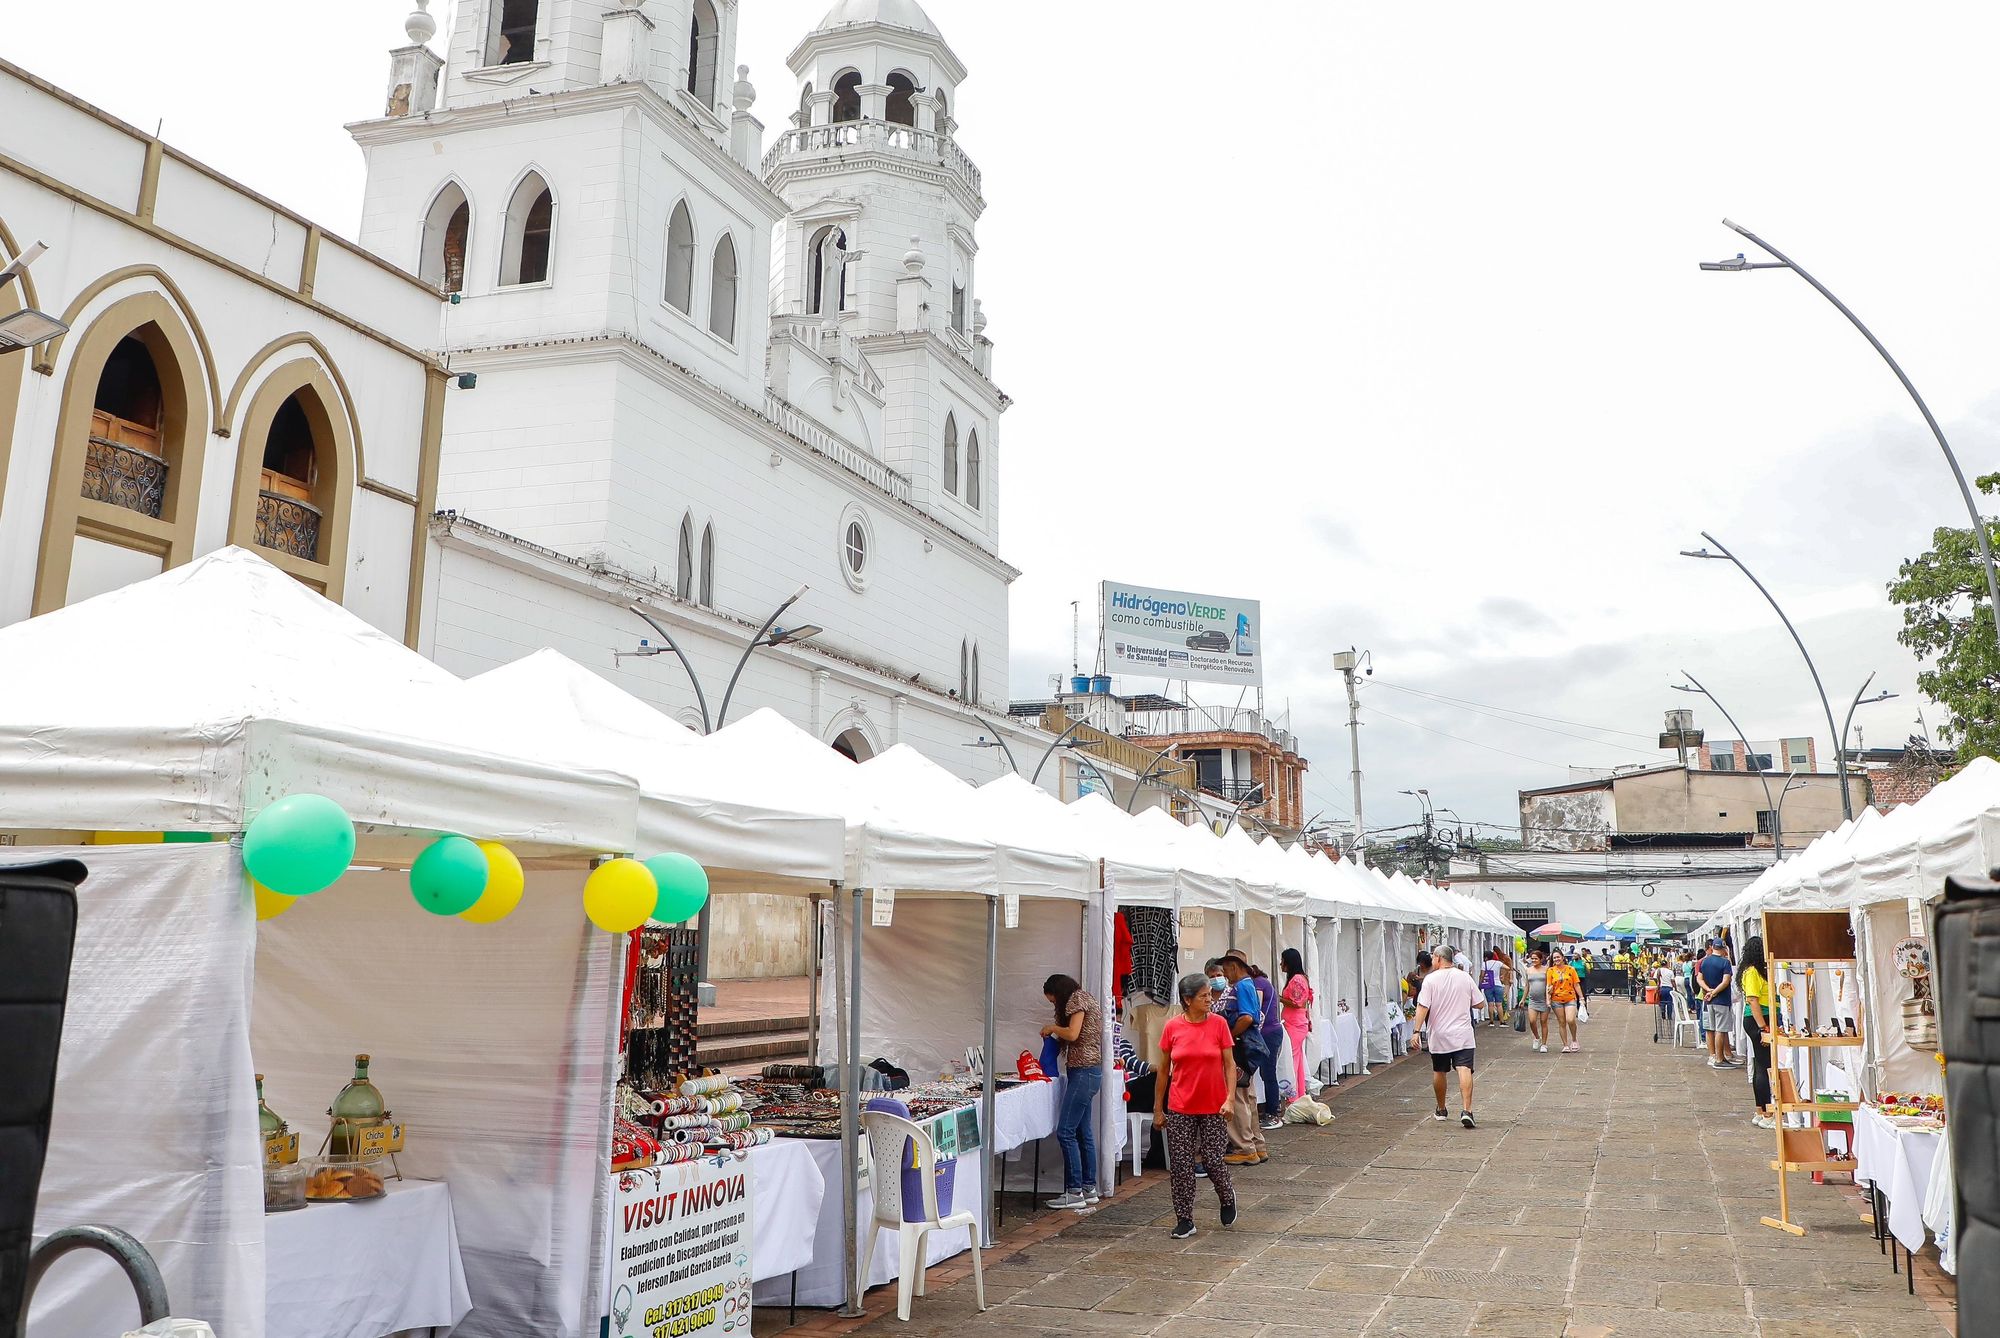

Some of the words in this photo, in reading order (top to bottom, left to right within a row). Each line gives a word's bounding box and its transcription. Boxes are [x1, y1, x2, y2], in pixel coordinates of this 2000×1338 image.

[1112, 612, 1140, 625] como
[1143, 617, 1204, 632] combustible
[1126, 645, 1168, 656] Universidad
[1126, 652, 1135, 660] de
[1136, 653, 1168, 663] Santander
[1190, 655, 1219, 664] Doctorado
[1227, 659, 1252, 667] Recursos
[1190, 663, 1223, 672] Energéticos
[1224, 666, 1255, 674] Renovables
[366, 1131, 385, 1140] Chicha
[363, 1147, 383, 1156] Corozo
[624, 1192, 678, 1234] VISUT
[681, 1173, 746, 1217] INNOVA
[621, 1239, 658, 1261] Elaborado
[659, 1236, 673, 1249] con
[701, 1223, 713, 1237] por
[713, 1214, 738, 1233] persona
[738, 1212, 745, 1224] en
[628, 1256, 665, 1278] condicion
[666, 1252, 676, 1266] de
[676, 1236, 721, 1263] Discapacidad
[721, 1229, 739, 1248] Visual
[637, 1274, 669, 1294] Jeferson
[669, 1264, 690, 1284] David
[690, 1258, 712, 1277] Garcia
[712, 1251, 732, 1269] Garcia
[665, 1297, 683, 1319] 317
[683, 1290, 700, 1313] 317
[700, 1282, 724, 1307] 0949
[653, 1322, 670, 1338] 317
[670, 1316, 689, 1337] 421
[690, 1306, 715, 1332] 9600
